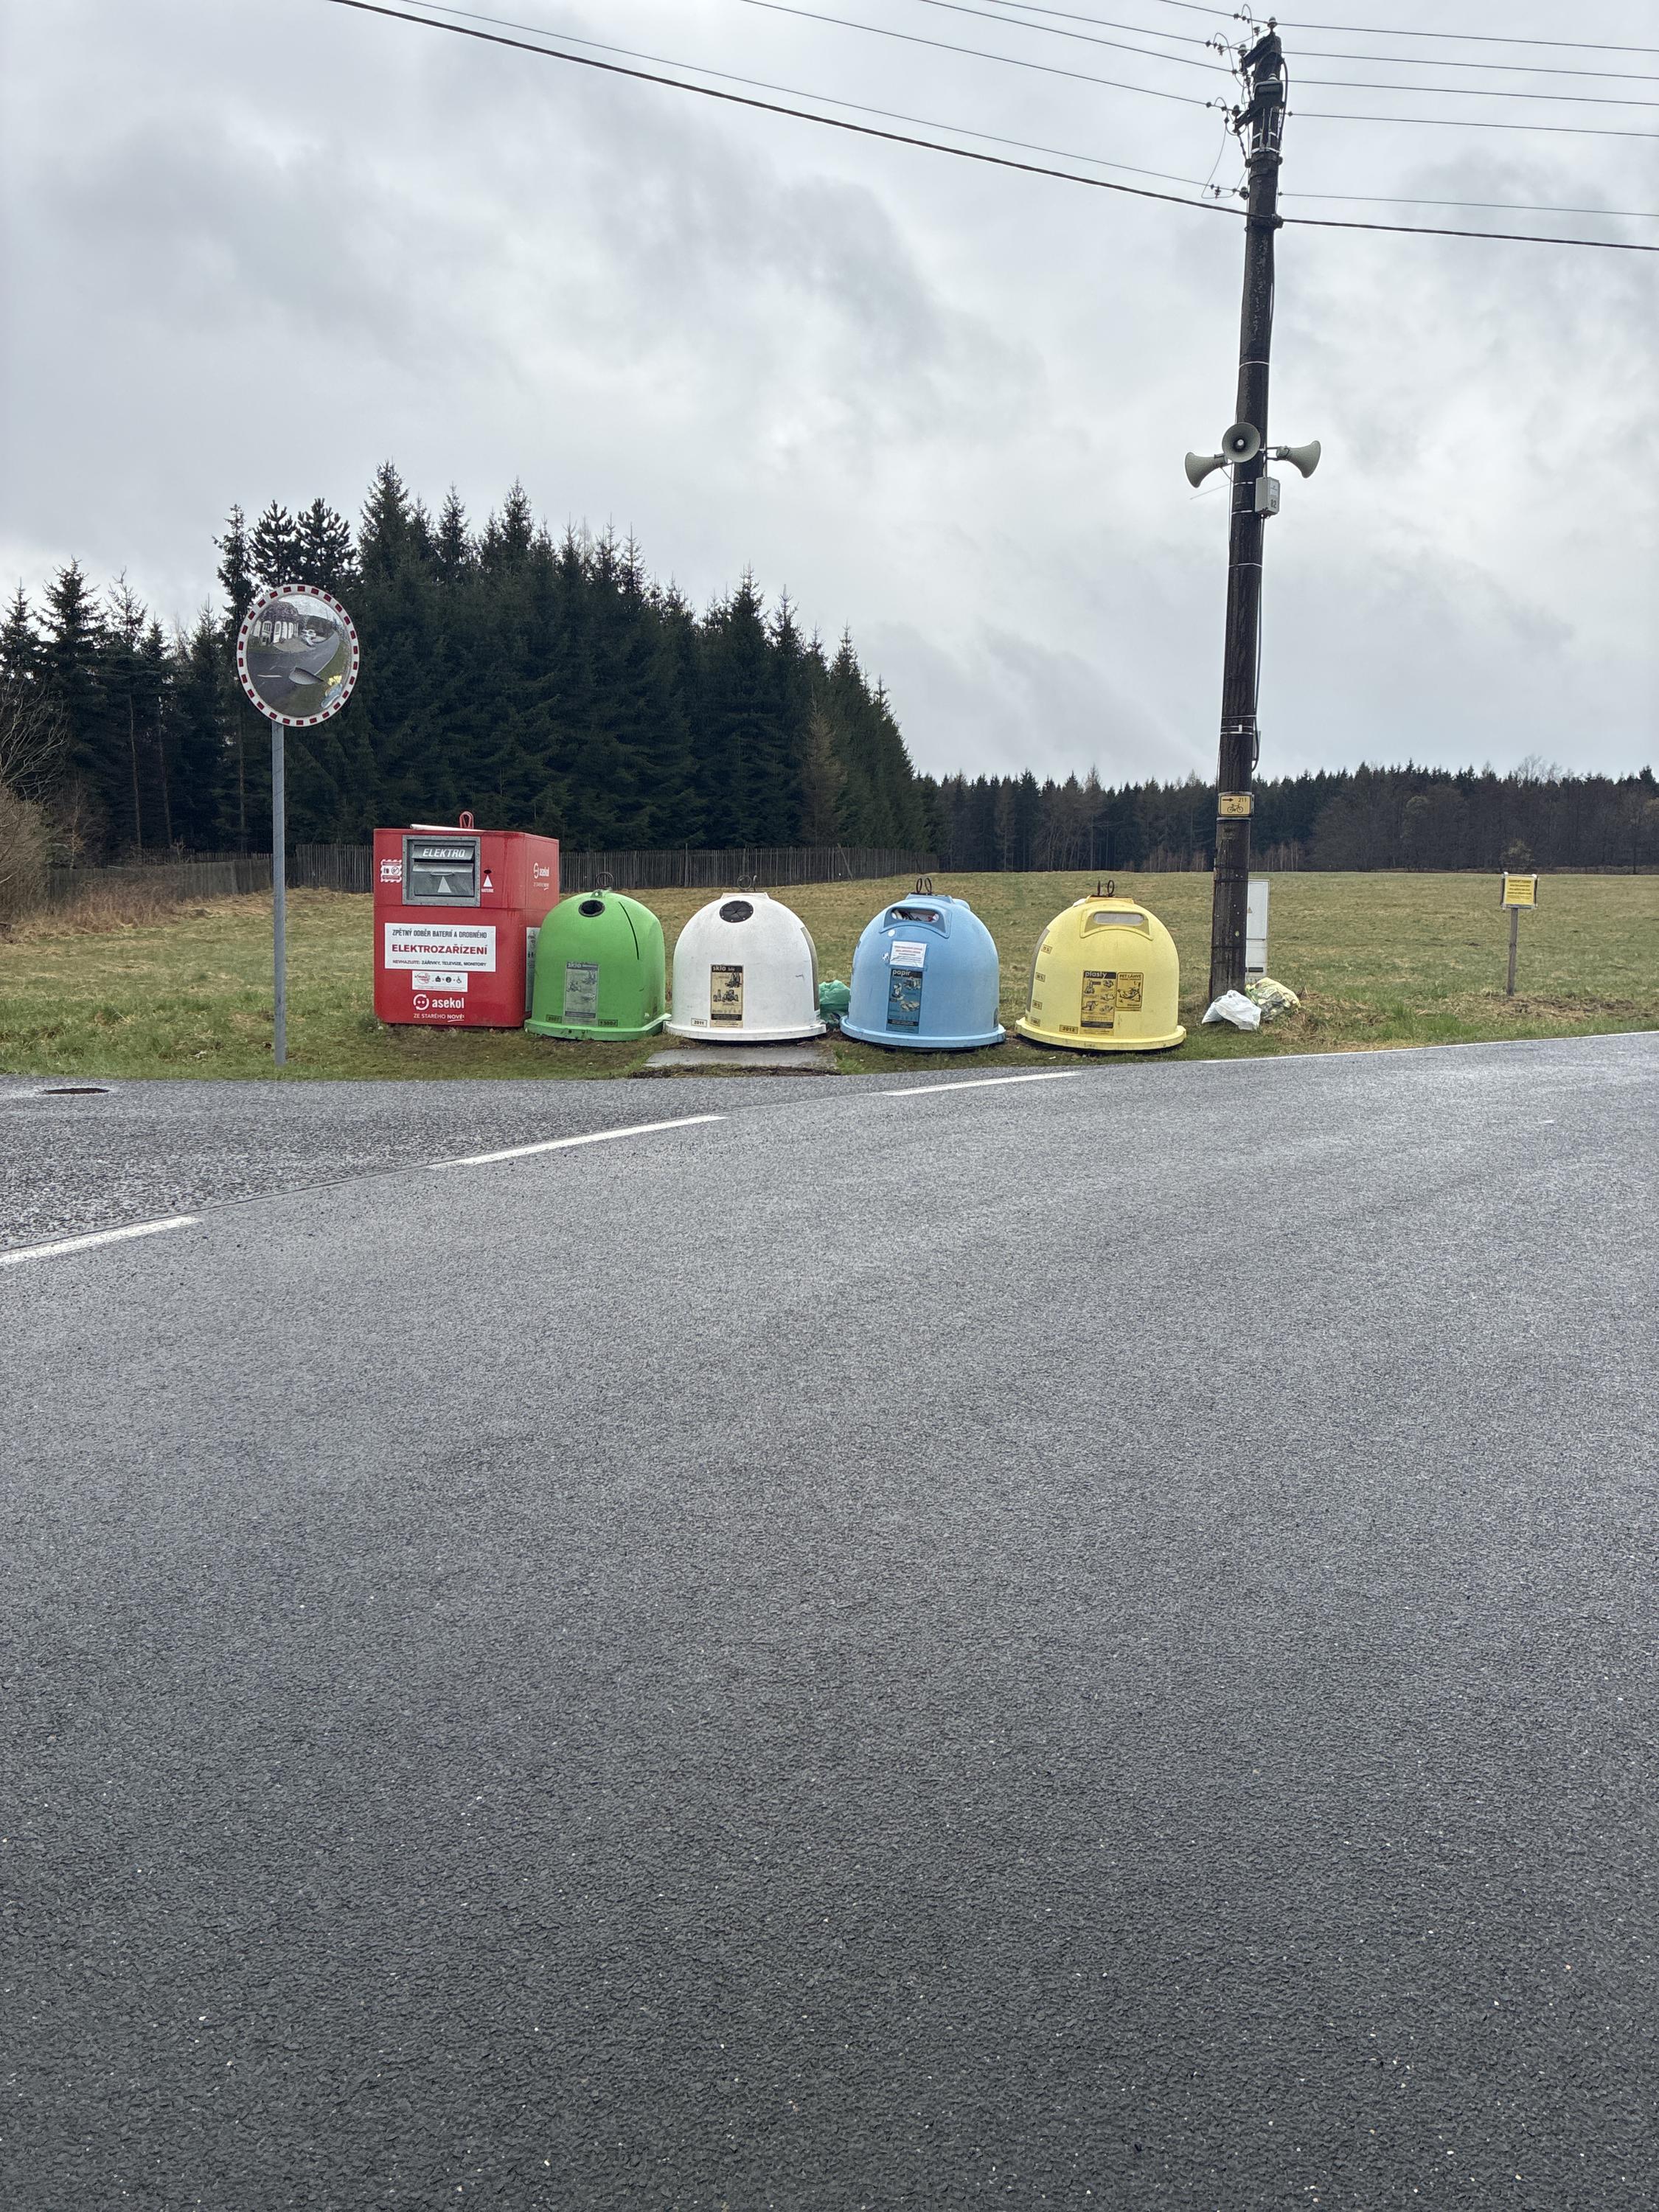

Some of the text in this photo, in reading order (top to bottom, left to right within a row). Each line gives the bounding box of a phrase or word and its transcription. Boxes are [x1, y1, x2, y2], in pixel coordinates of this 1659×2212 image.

[422, 848, 466, 858] ELEKTRO
[392, 928, 412, 936] ZPĚTNÝ
[413, 929, 431, 937] ODBĚR
[432, 930, 453, 938] BATERIÍ
[459, 931, 487, 939] DROBNÉHO
[392, 943, 488, 955] ELEKTROZAŘÍZENÍ
[892, 968, 911, 976] papír
[431, 997, 465, 1009] asekol
